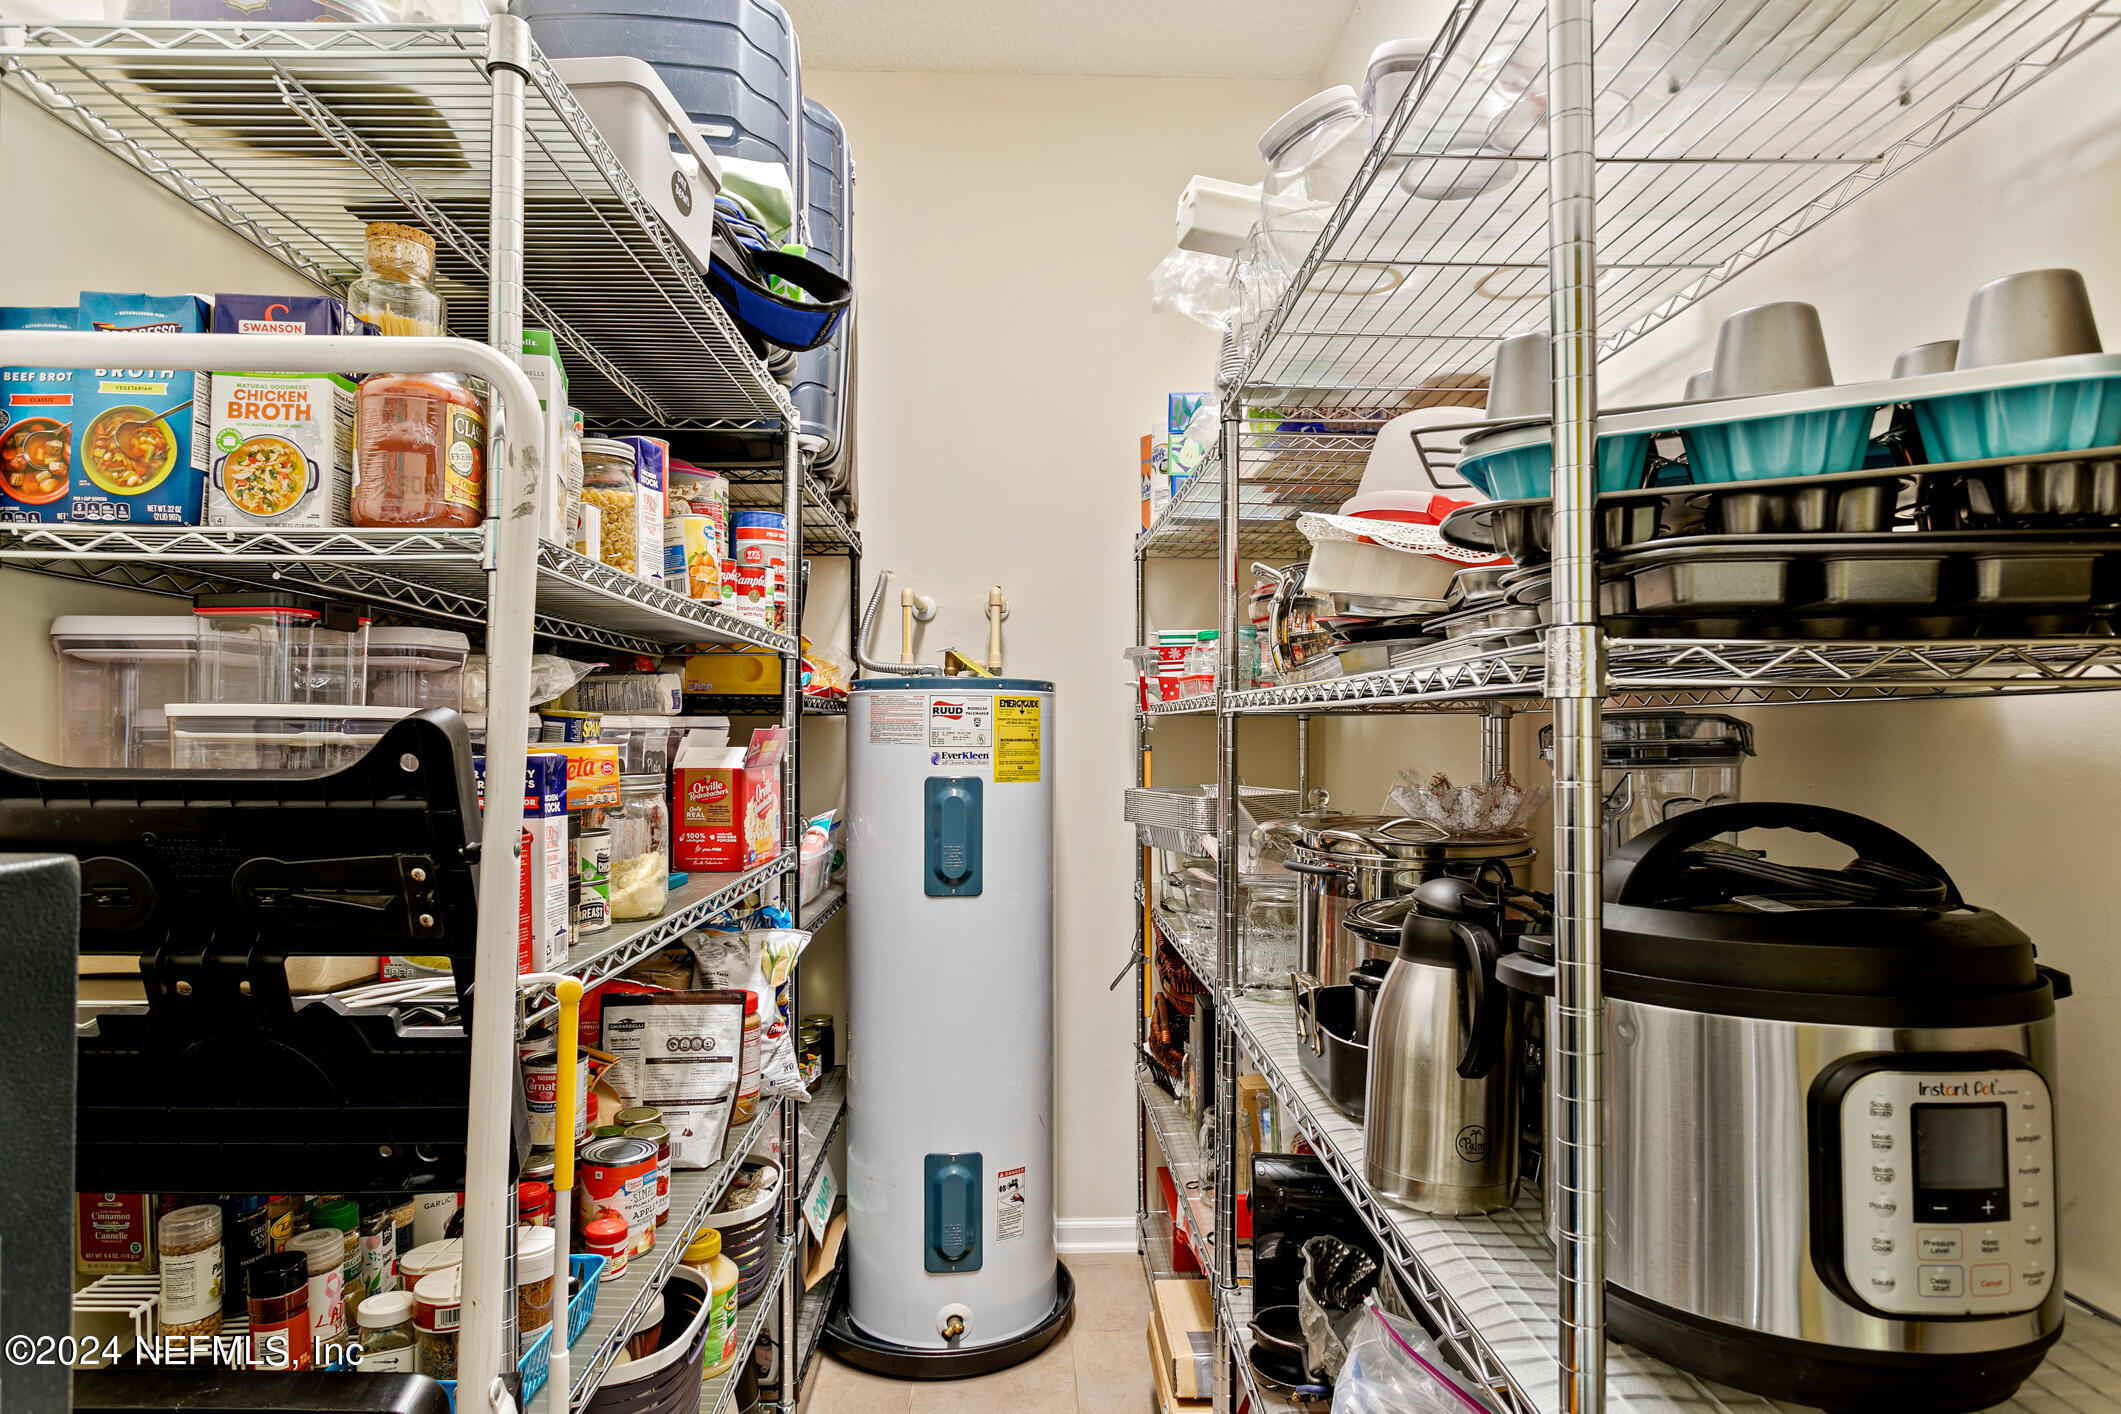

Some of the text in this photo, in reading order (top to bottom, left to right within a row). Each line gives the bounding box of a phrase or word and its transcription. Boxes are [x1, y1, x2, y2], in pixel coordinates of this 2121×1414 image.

[243, 323, 302, 334] SWANSON
[4, 371, 36, 382] BEEF
[233, 388, 308, 403] CHICKEN
[227, 401, 311, 421] BROTH
[932, 706, 963, 715] RUUD
[941, 751, 989, 760] EverKleen
[693, 781, 723, 794] Orville
[1919, 1081, 1969, 1097] Instant
[1974, 1080, 1997, 1096] Pot
[1871, 1141, 1892, 1150] Stew
[1868, 1202, 1897, 1212] Poultry
[91, 1211, 131, 1221] Cinnamon
[95, 1231, 129, 1240] Cannelle
[1872, 1236, 1892, 1244] Slow
[1923, 1239, 1956, 1247] Pressure
[1981, 1239, 1999, 1248] Keep
[1872, 1244, 1892, 1252] Cook
[1930, 1247, 1950, 1255] Level
[1930, 1276, 1951, 1287] Delay
[1980, 1280, 2003, 1289] Cancel
[1931, 1284, 1950, 1292] Start
